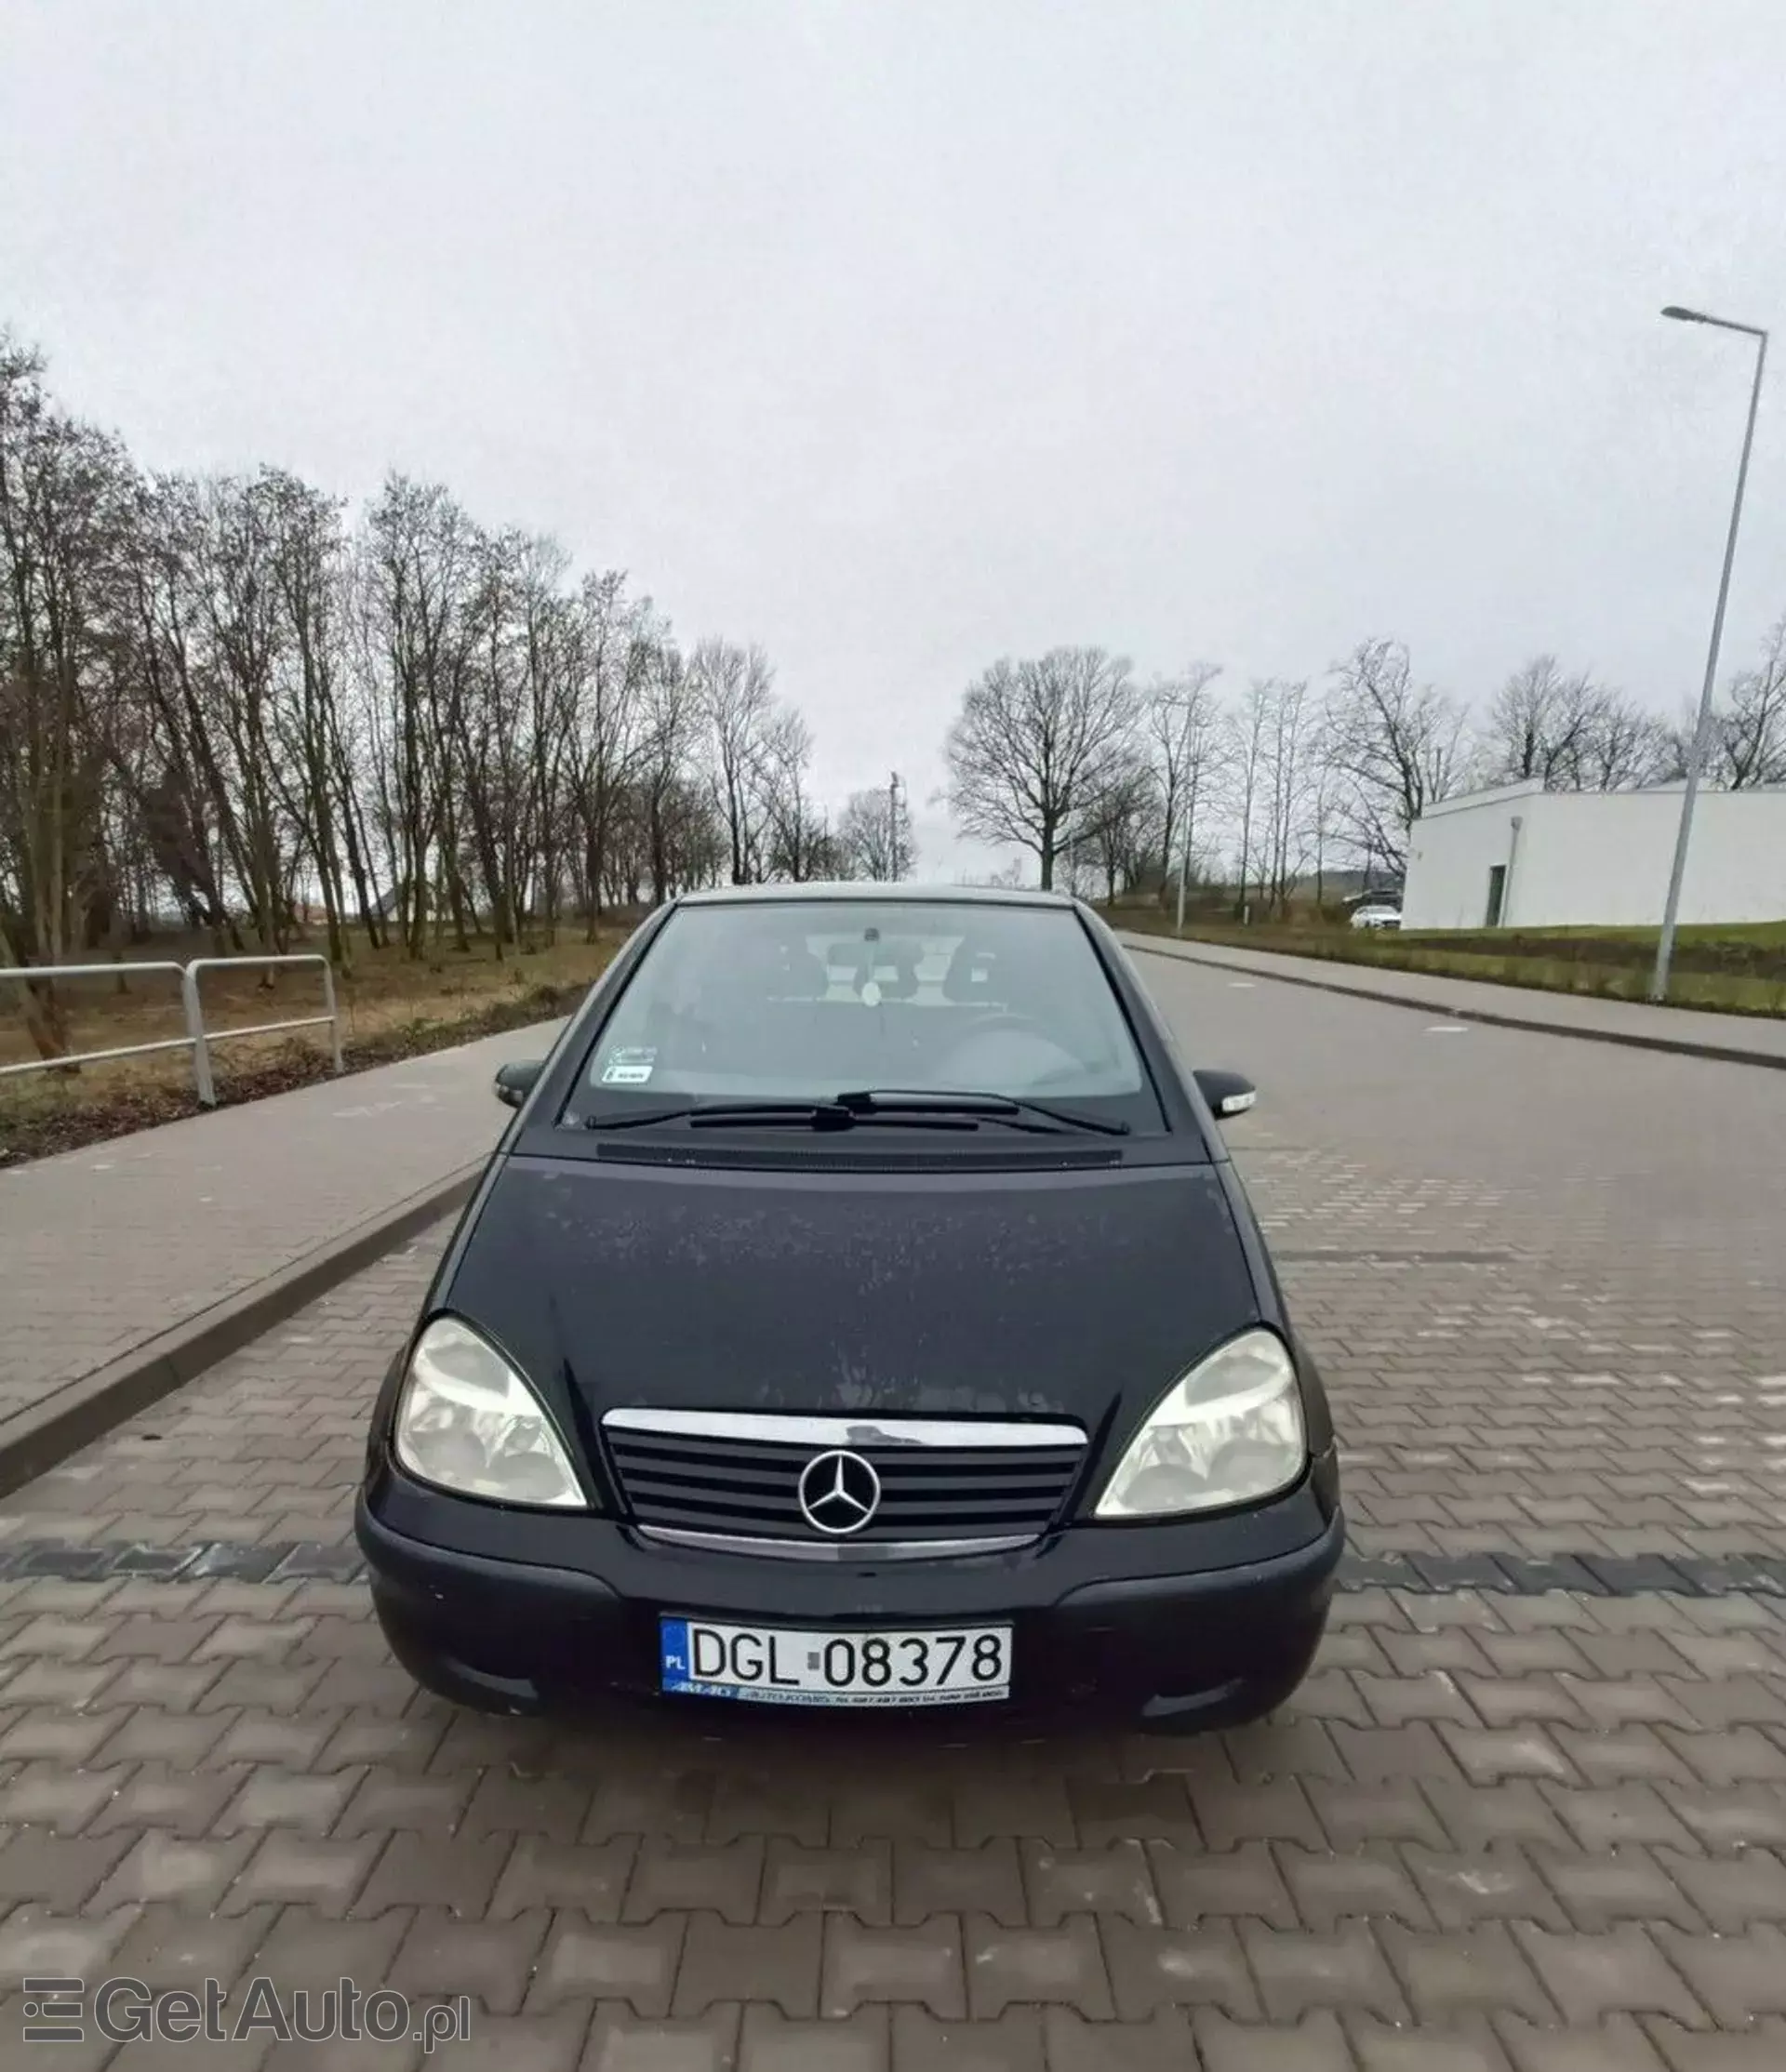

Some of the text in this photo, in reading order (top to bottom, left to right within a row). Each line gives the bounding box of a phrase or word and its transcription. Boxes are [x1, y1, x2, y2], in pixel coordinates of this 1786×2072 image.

[665, 1654, 686, 1670] PL
[692, 1628, 1002, 1687] DGL 08378
